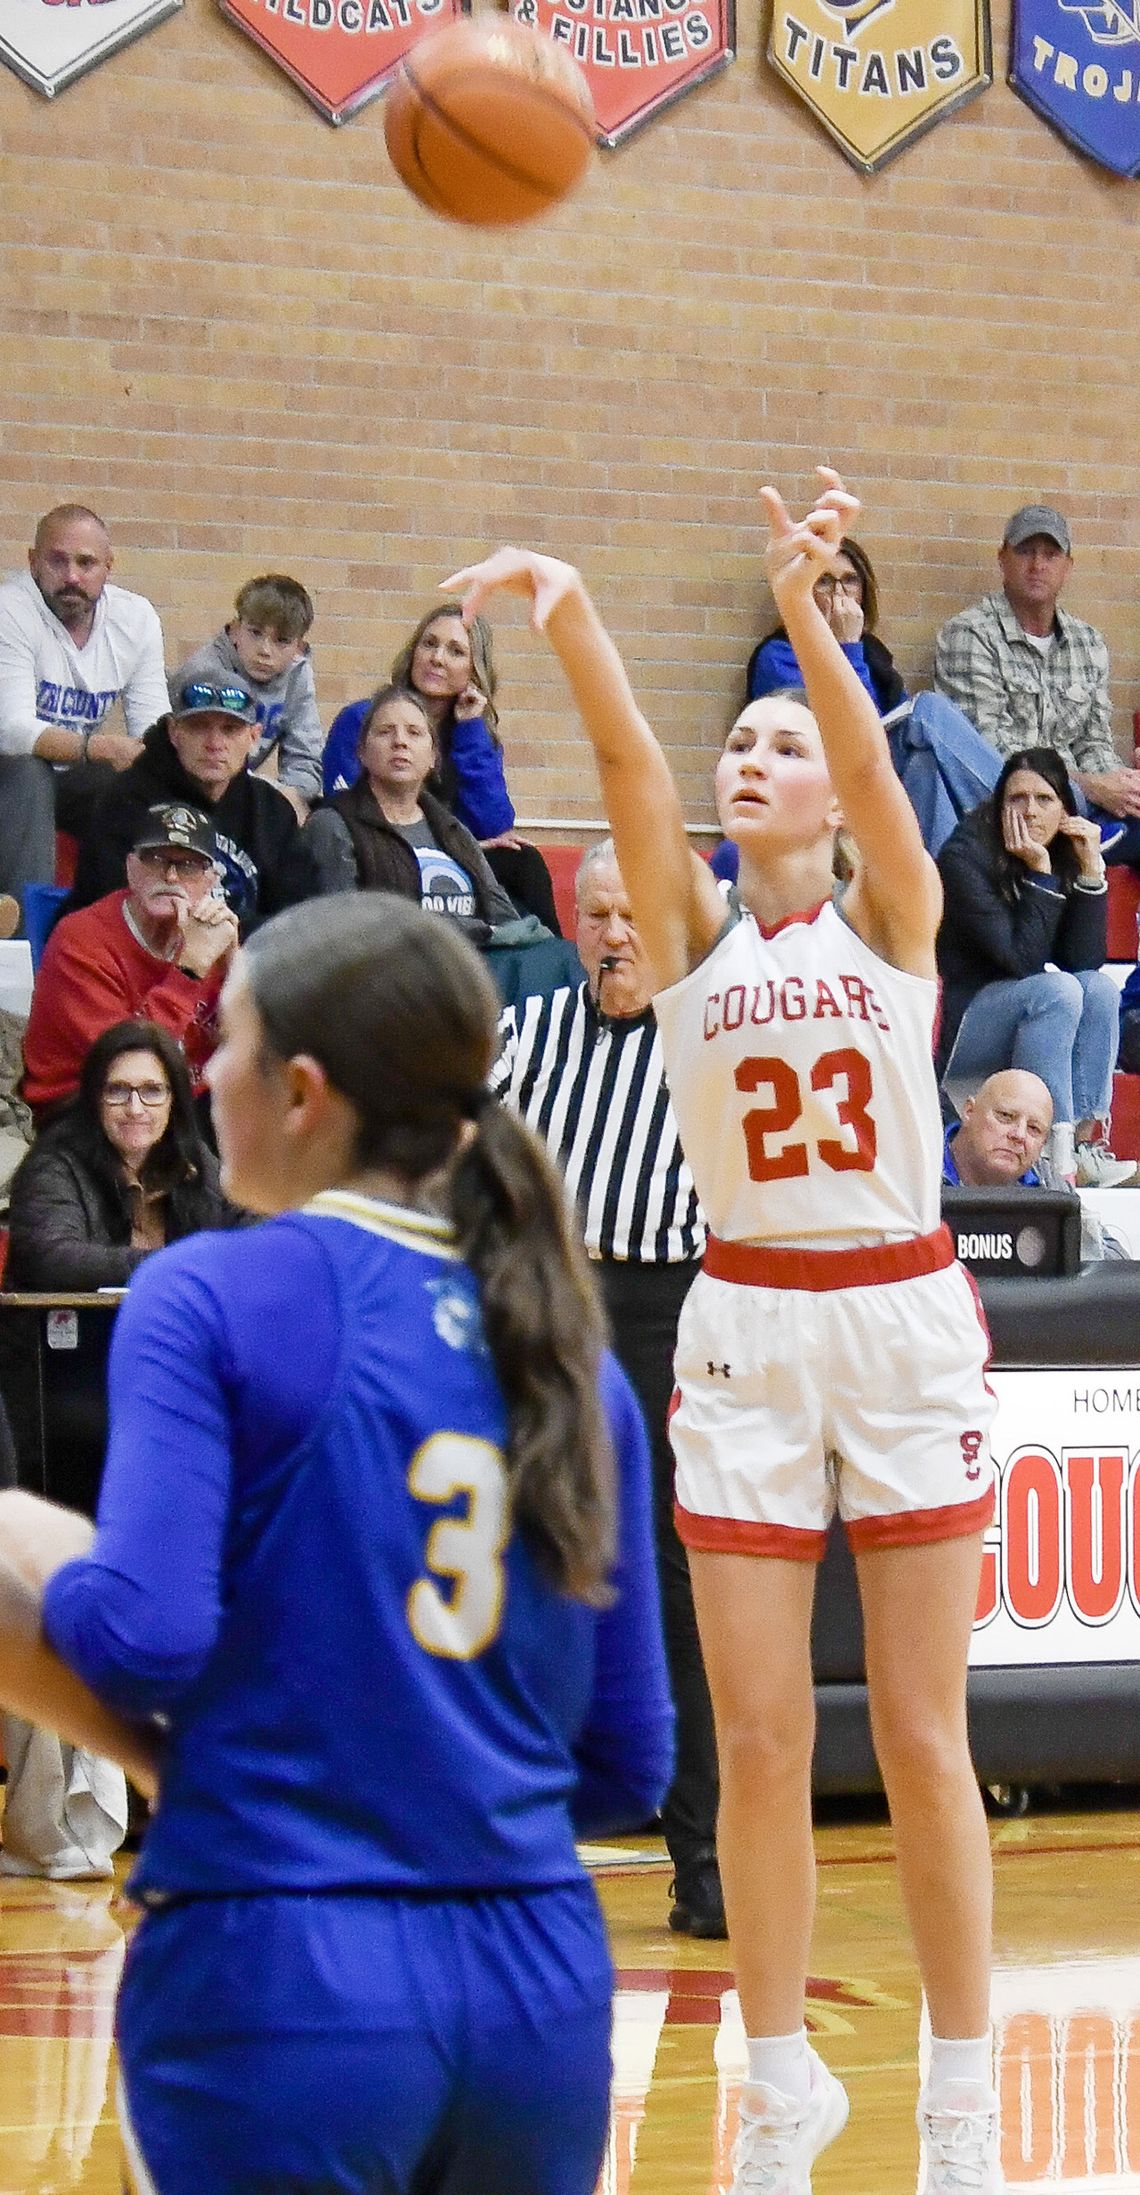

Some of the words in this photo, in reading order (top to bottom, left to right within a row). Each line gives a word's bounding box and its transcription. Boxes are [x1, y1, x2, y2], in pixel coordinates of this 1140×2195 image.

[254, 0, 441, 32] LDCAT
[553, 14, 709, 64] FILLIES
[785, 17, 960, 95] TITANS
[1032, 34, 1140, 103] TROJ
[704, 974, 890, 1041] COUGARS
[733, 1047, 878, 1183] 23
[957, 1233, 1013, 1260] BONUS
[1073, 1388, 1140, 1413] HOM
[407, 1431, 513, 1661] 3
